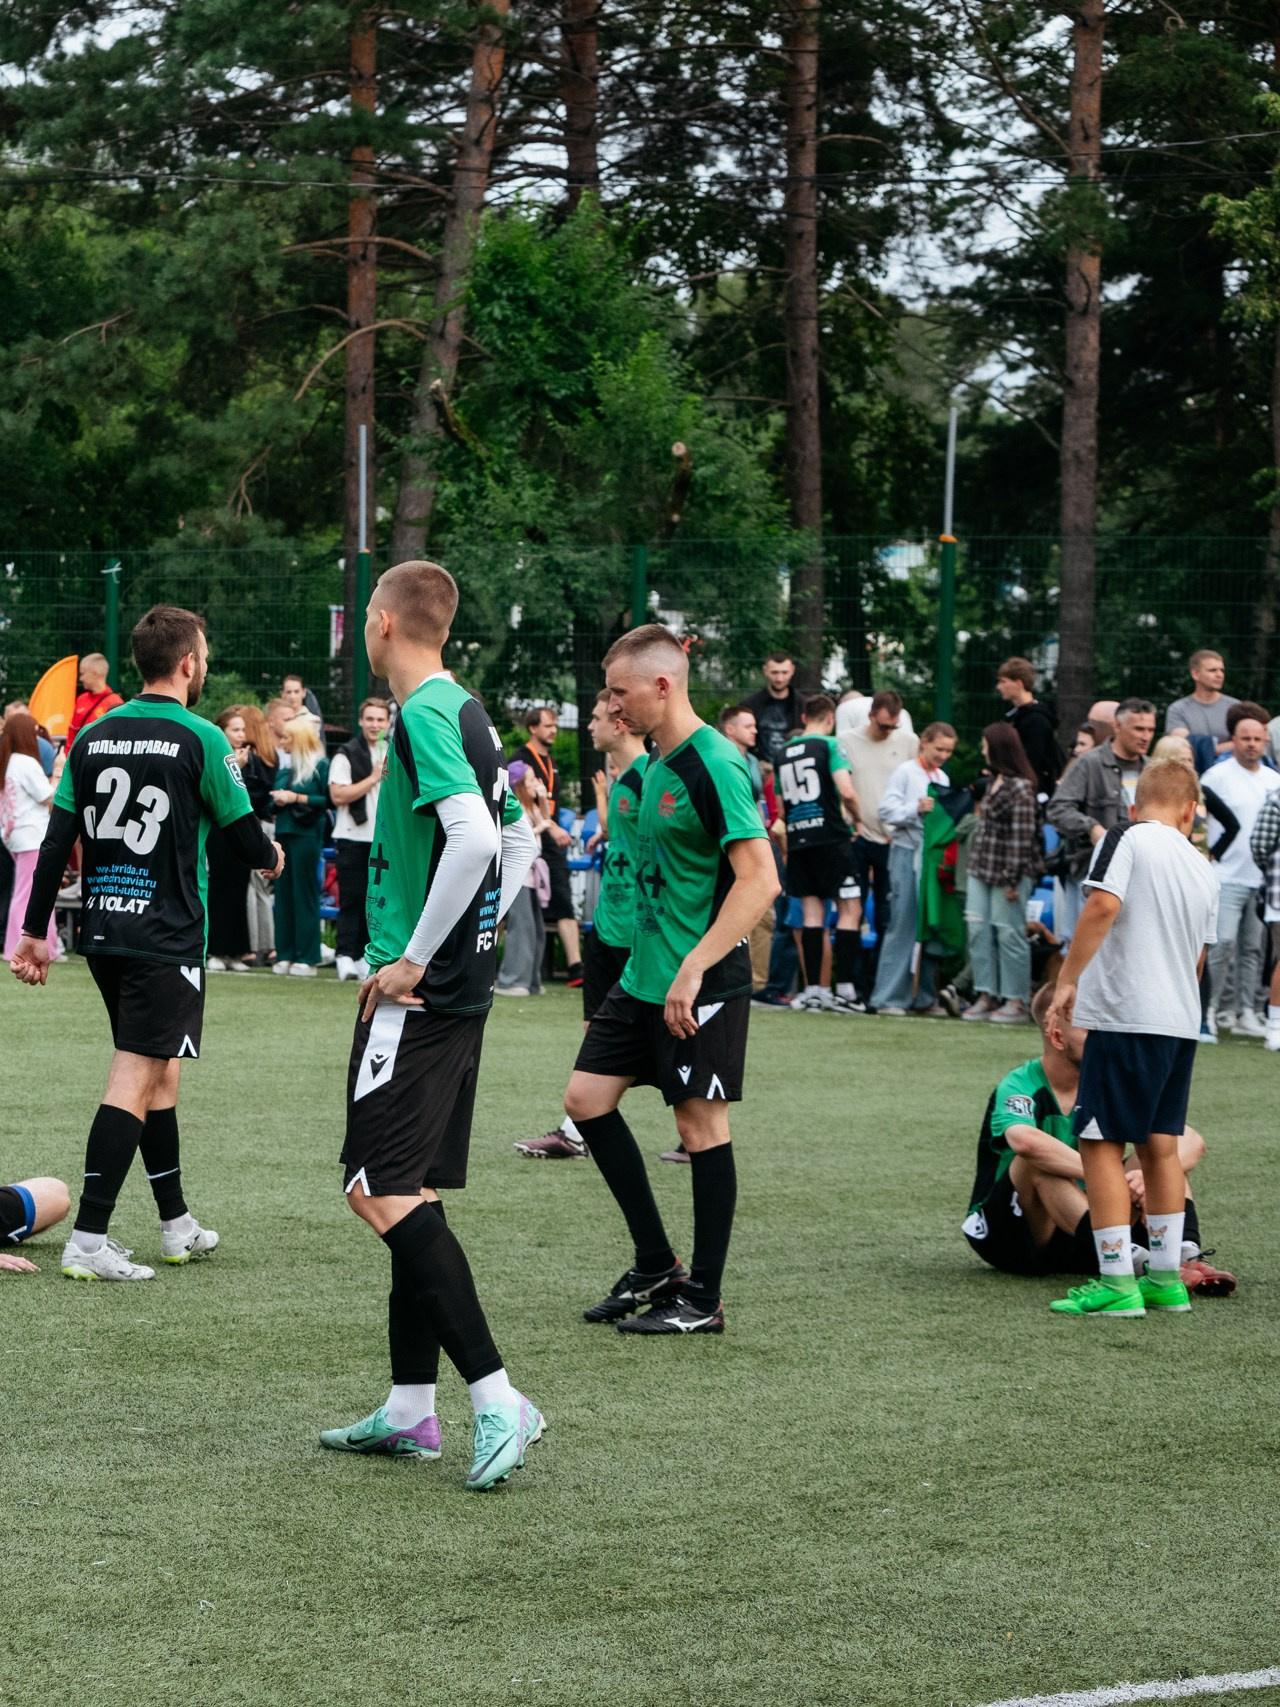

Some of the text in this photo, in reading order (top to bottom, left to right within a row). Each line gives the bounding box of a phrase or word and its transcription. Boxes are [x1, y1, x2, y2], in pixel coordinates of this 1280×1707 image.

[87, 739, 180, 758] ТОЛЬКО ПРАВАЯ
[779, 757, 821, 806] 45
[476, 930, 493, 953] FC
